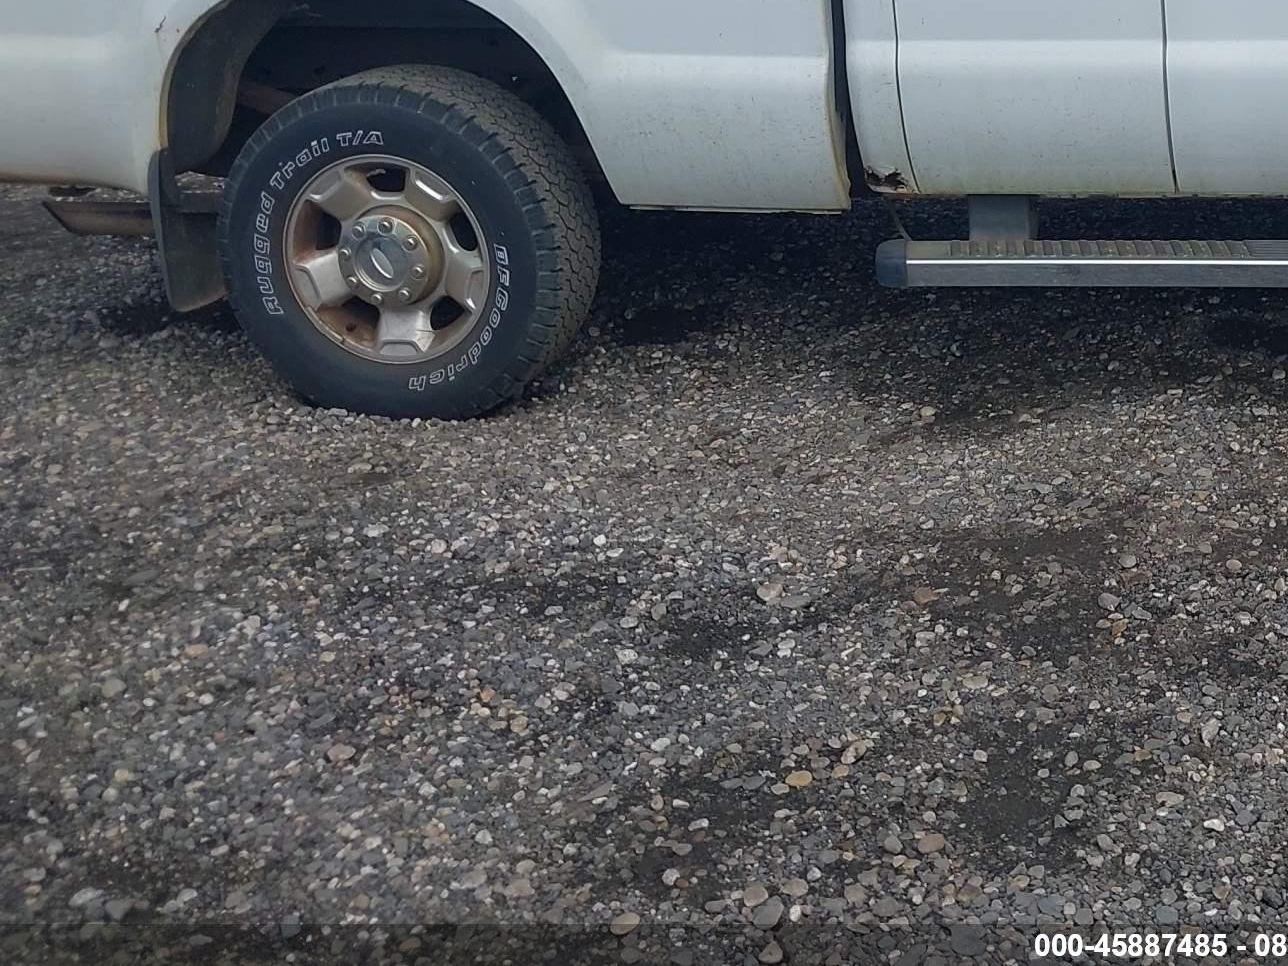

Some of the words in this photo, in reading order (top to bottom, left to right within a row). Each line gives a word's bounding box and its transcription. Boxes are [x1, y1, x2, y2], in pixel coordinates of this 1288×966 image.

[253, 191, 285, 316] Rugged
[269, 137, 330, 190] Trail
[335, 129, 384, 147] T/A
